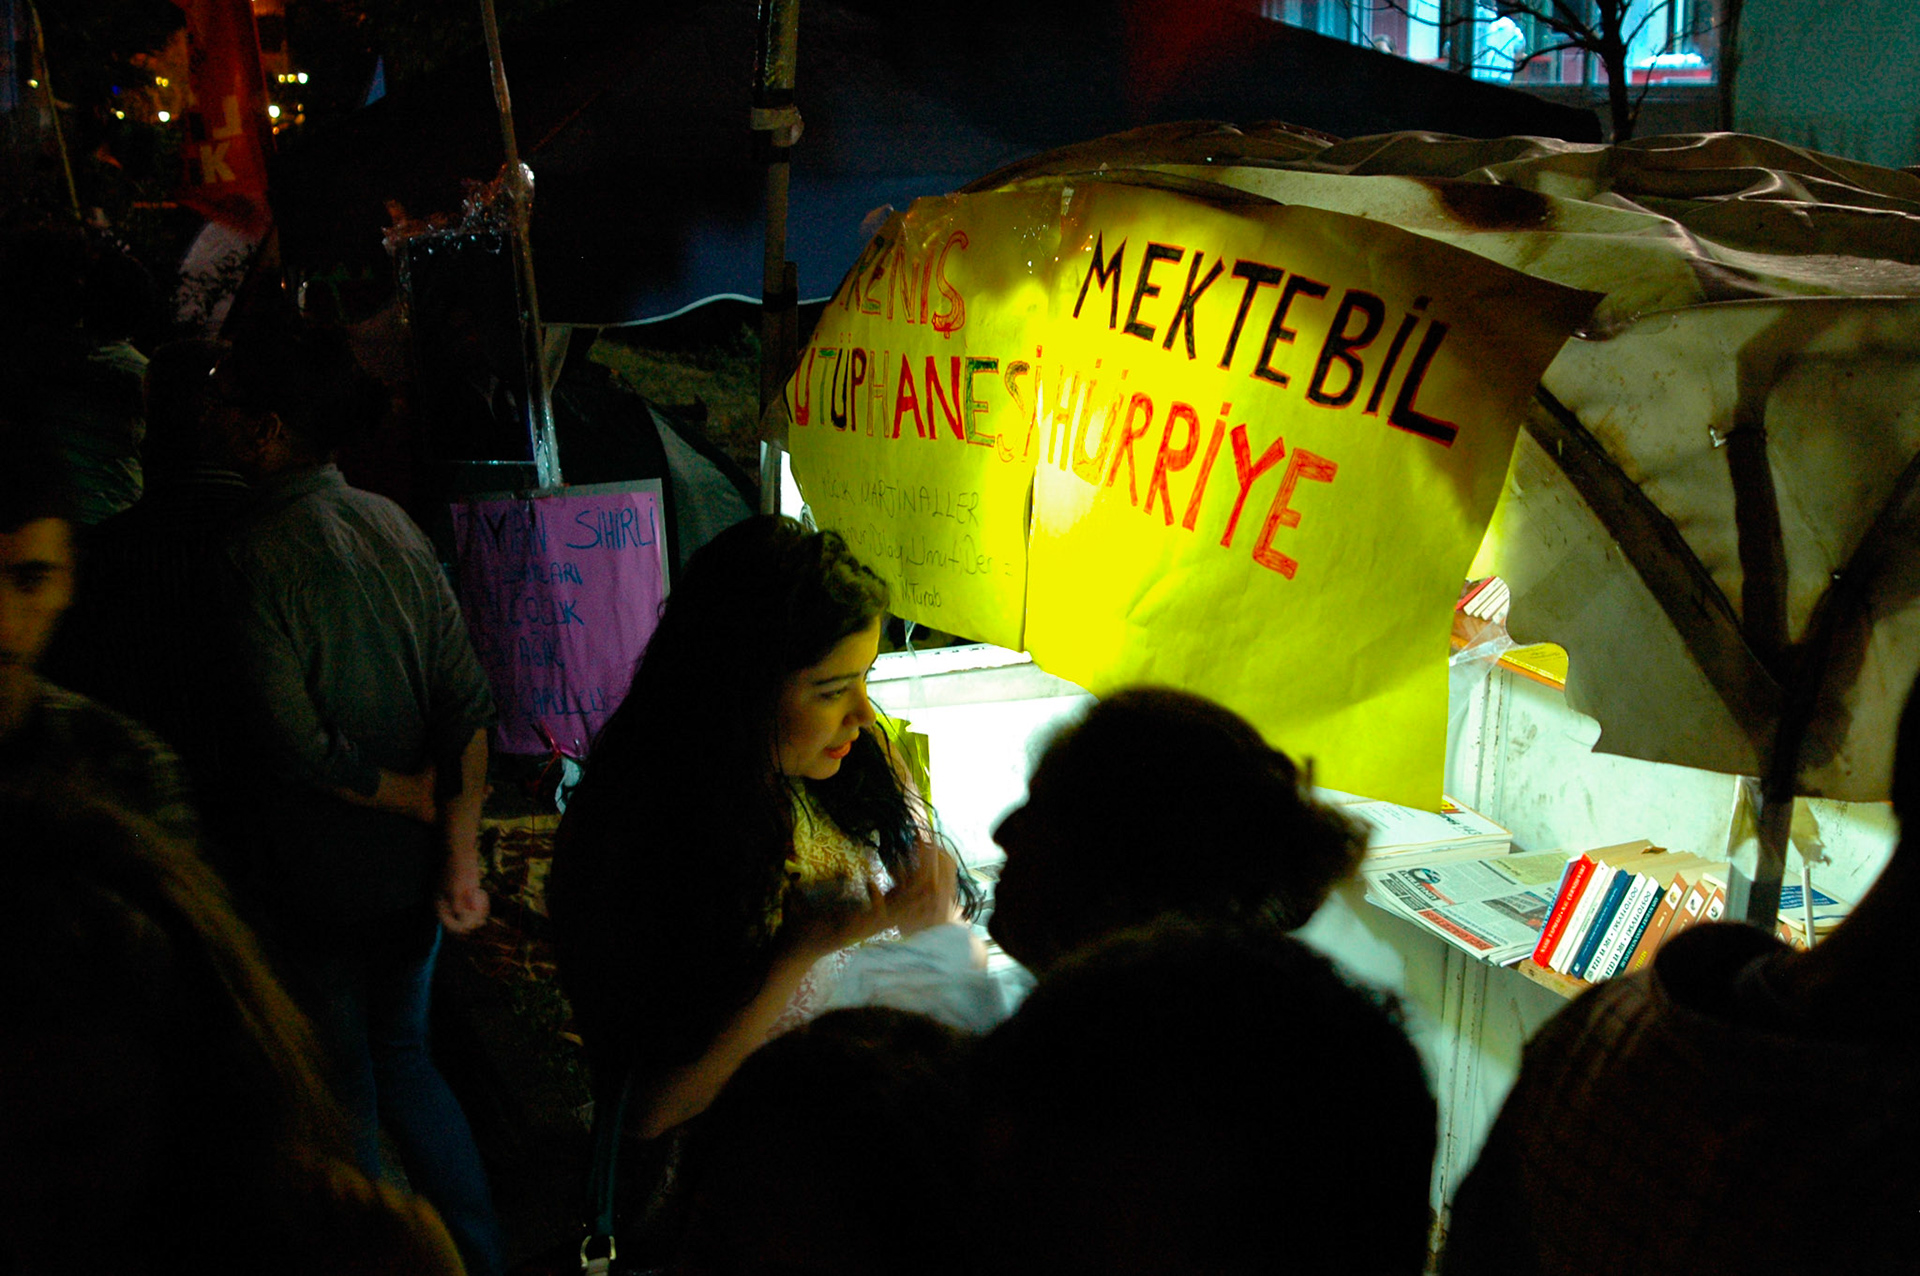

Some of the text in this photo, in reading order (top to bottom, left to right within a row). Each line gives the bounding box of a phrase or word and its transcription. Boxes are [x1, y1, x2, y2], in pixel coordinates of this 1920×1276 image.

[783, 331, 1043, 463] ÜTÜPHANESİ
[1073, 230, 1459, 448] MEKTEBİL
[1047, 358, 1338, 580] HÜRRİYE
[1613, 887, 1638, 931] DOSTOYEVSKİ
[1626, 891, 1651, 936] DOSTOYEVSKİ
